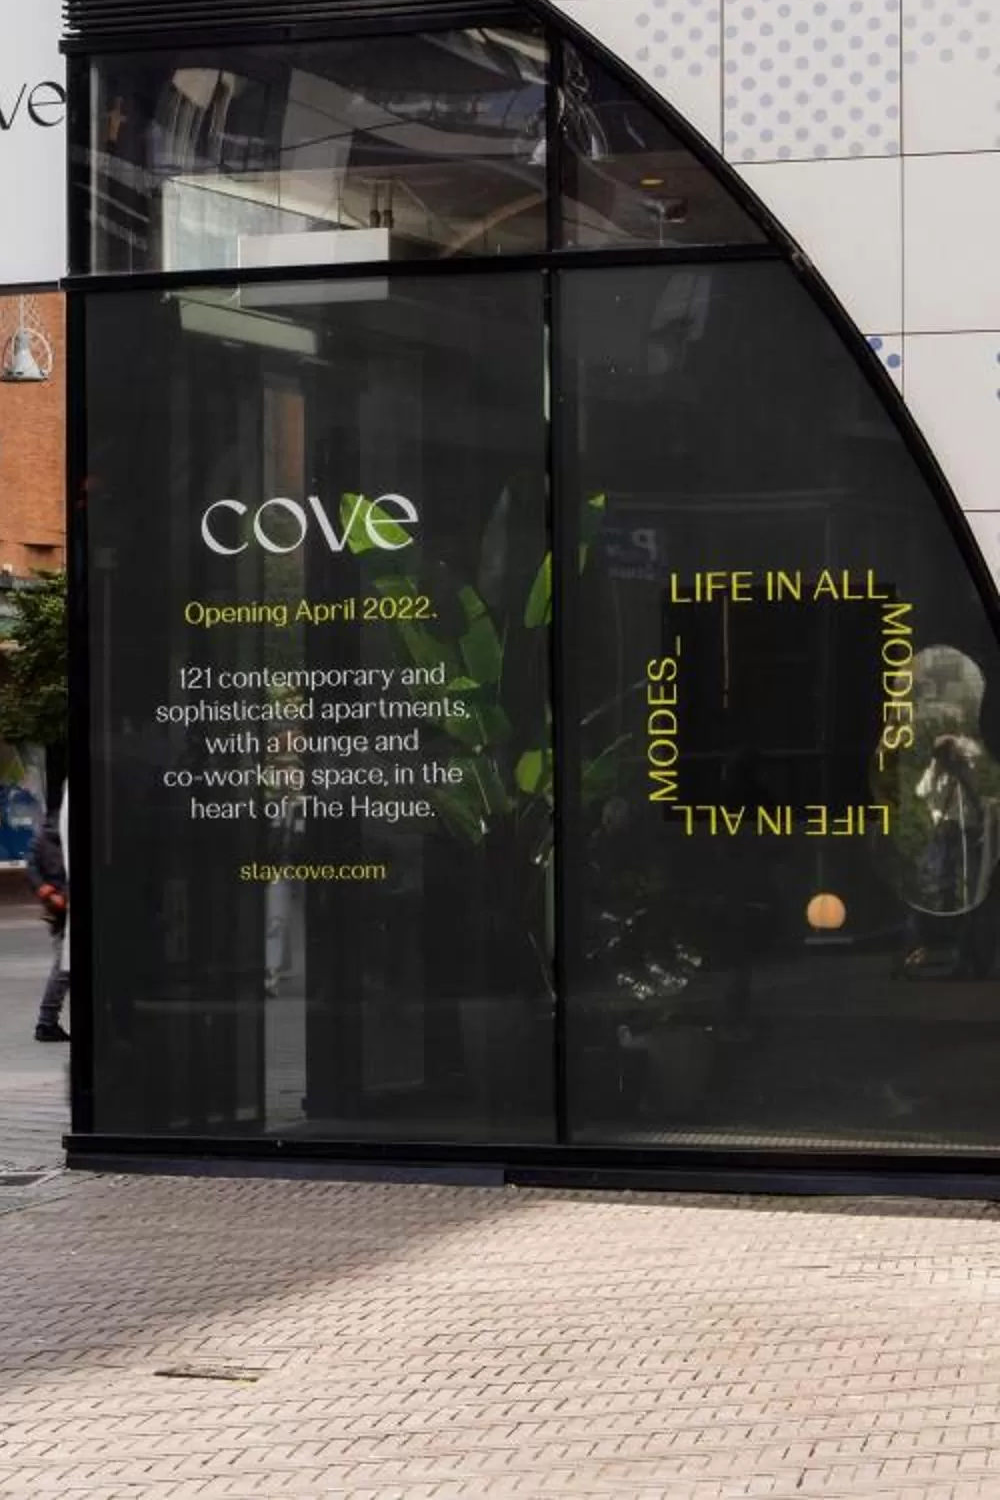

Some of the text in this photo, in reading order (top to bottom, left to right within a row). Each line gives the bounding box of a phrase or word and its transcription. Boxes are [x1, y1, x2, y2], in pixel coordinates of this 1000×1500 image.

[201, 493, 419, 555] cove
[671, 571, 753, 603] LIFE
[766, 570, 801, 601] IN
[813, 568, 889, 601] ALL
[185, 596, 438, 628] Opening April 2022.
[180, 662, 446, 691] 121 contemporary and
[156, 697, 471, 726] sophisticated apartments,
[205, 728, 420, 757] with a lounge and
[163, 761, 464, 791] co-working space, in the
[190, 795, 437, 823] heart of The Hague.
[671, 804, 890, 836] LIFE IN ALL
[240, 862, 386, 883] staycove.com
